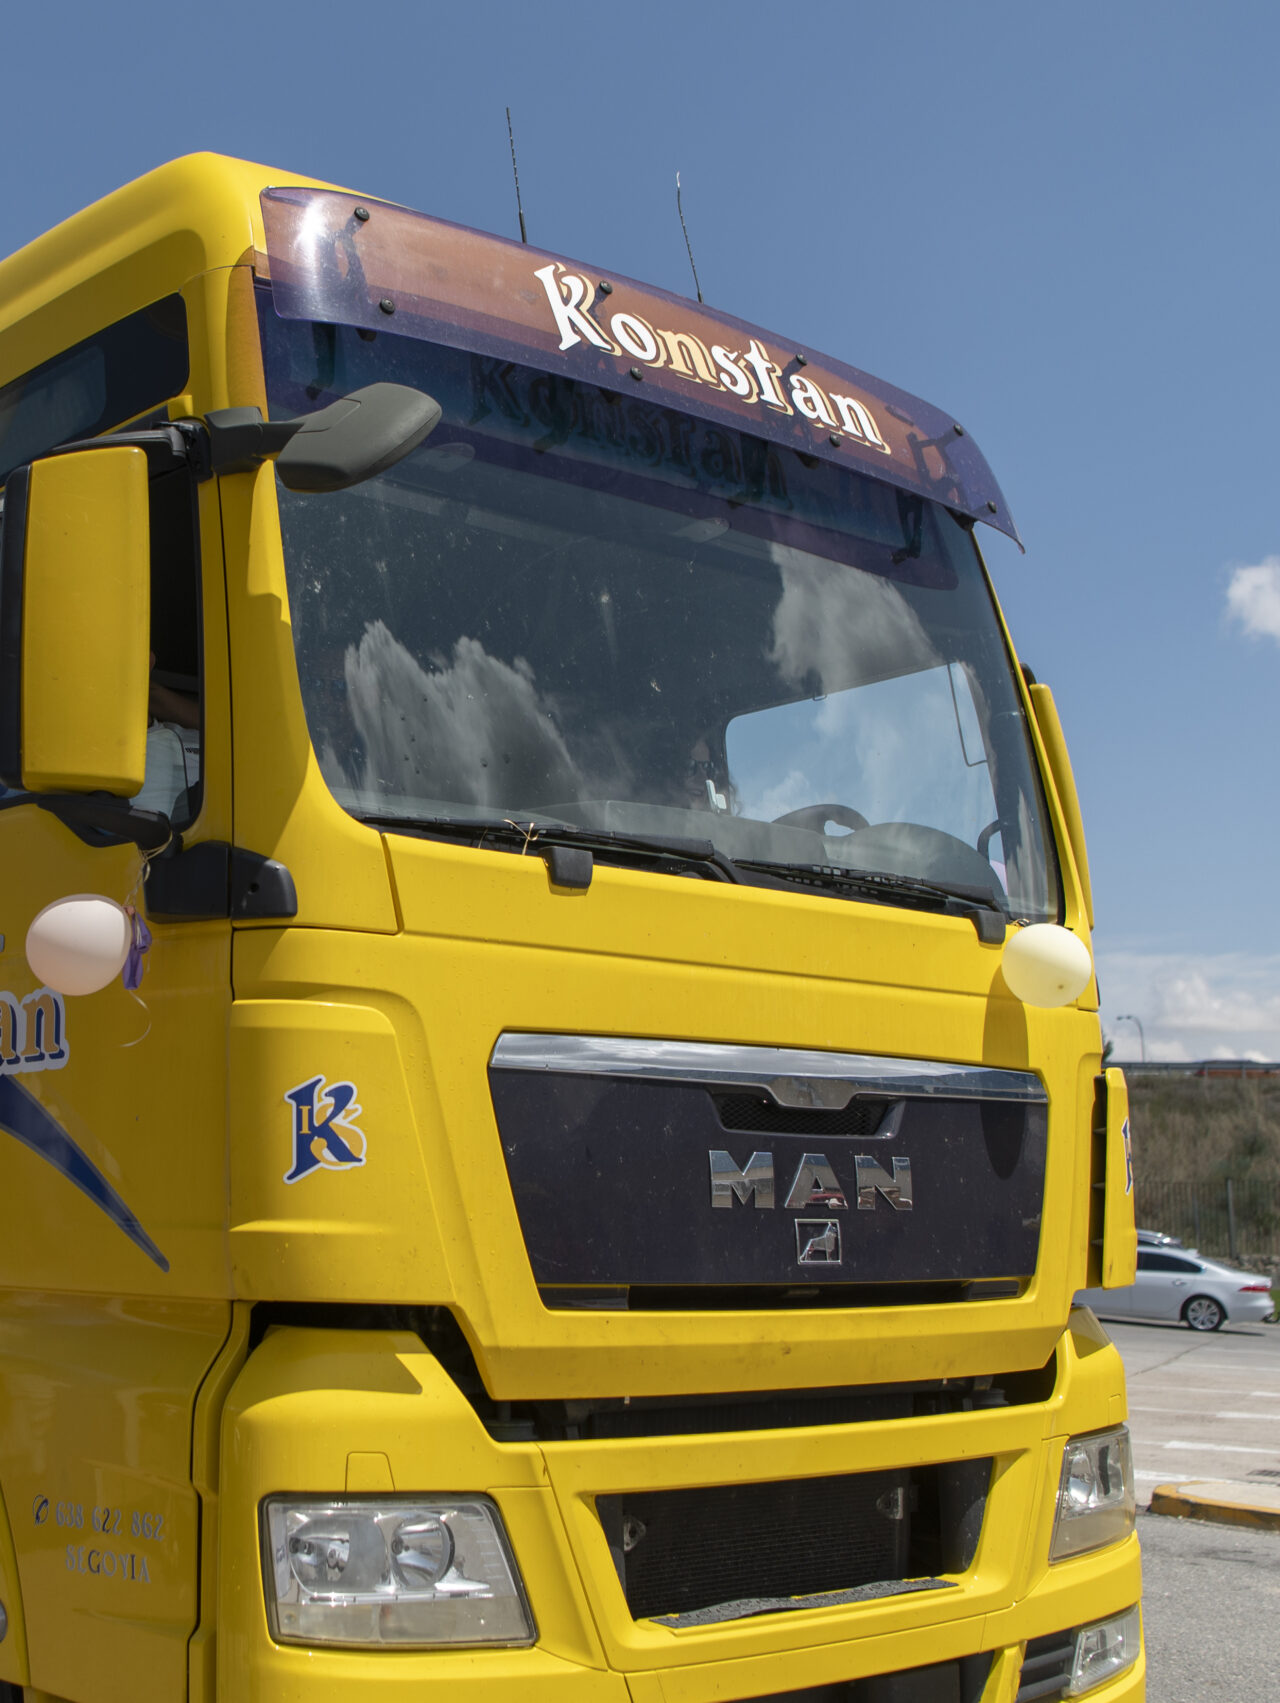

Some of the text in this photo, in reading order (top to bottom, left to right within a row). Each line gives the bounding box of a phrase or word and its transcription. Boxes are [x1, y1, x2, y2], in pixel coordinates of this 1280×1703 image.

[533, 261, 892, 456] Konstan
[708, 1150, 913, 1210] MAN
[55, 1501, 164, 1541] 638 622 862
[65, 1544, 151, 1584] SEGOVIA
